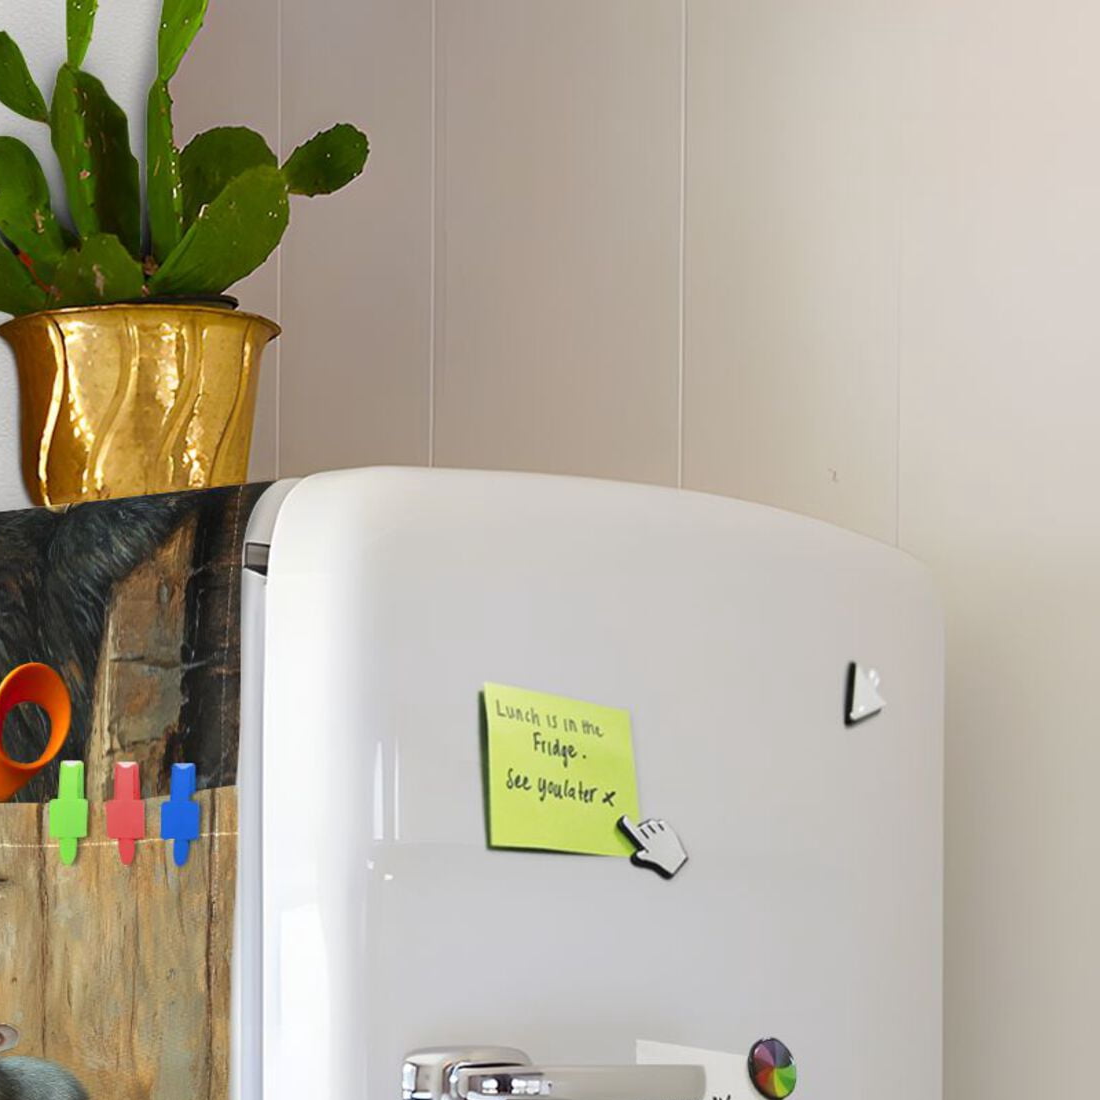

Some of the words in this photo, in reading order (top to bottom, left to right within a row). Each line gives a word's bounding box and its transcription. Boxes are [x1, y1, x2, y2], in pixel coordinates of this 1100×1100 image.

[496, 699, 540, 726] Lunch
[582, 719, 603, 737] the
[506, 768, 532, 790] See
